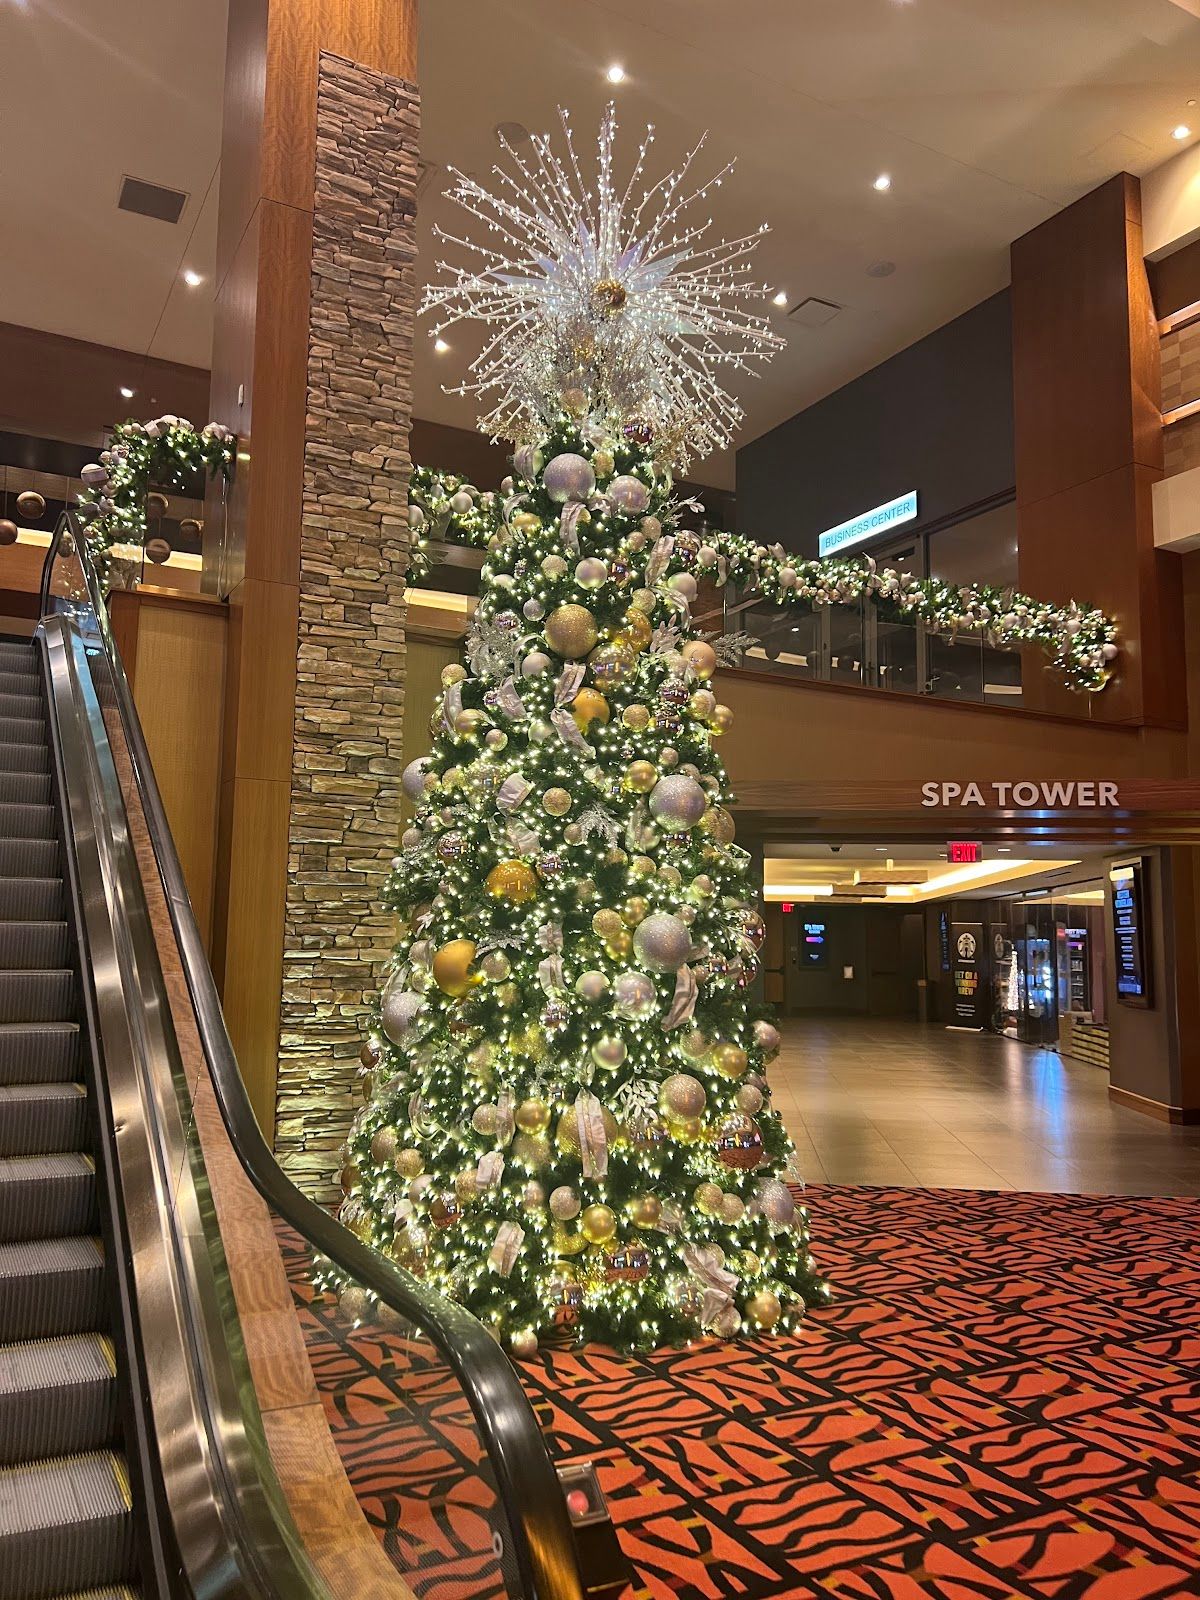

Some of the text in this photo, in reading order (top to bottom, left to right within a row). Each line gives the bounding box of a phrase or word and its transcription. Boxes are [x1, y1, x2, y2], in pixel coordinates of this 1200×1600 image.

[825, 502, 911, 548] BUSINESS CENTER
[921, 782, 1120, 807] SPA TOWER
[952, 844, 978, 862] EXIT
